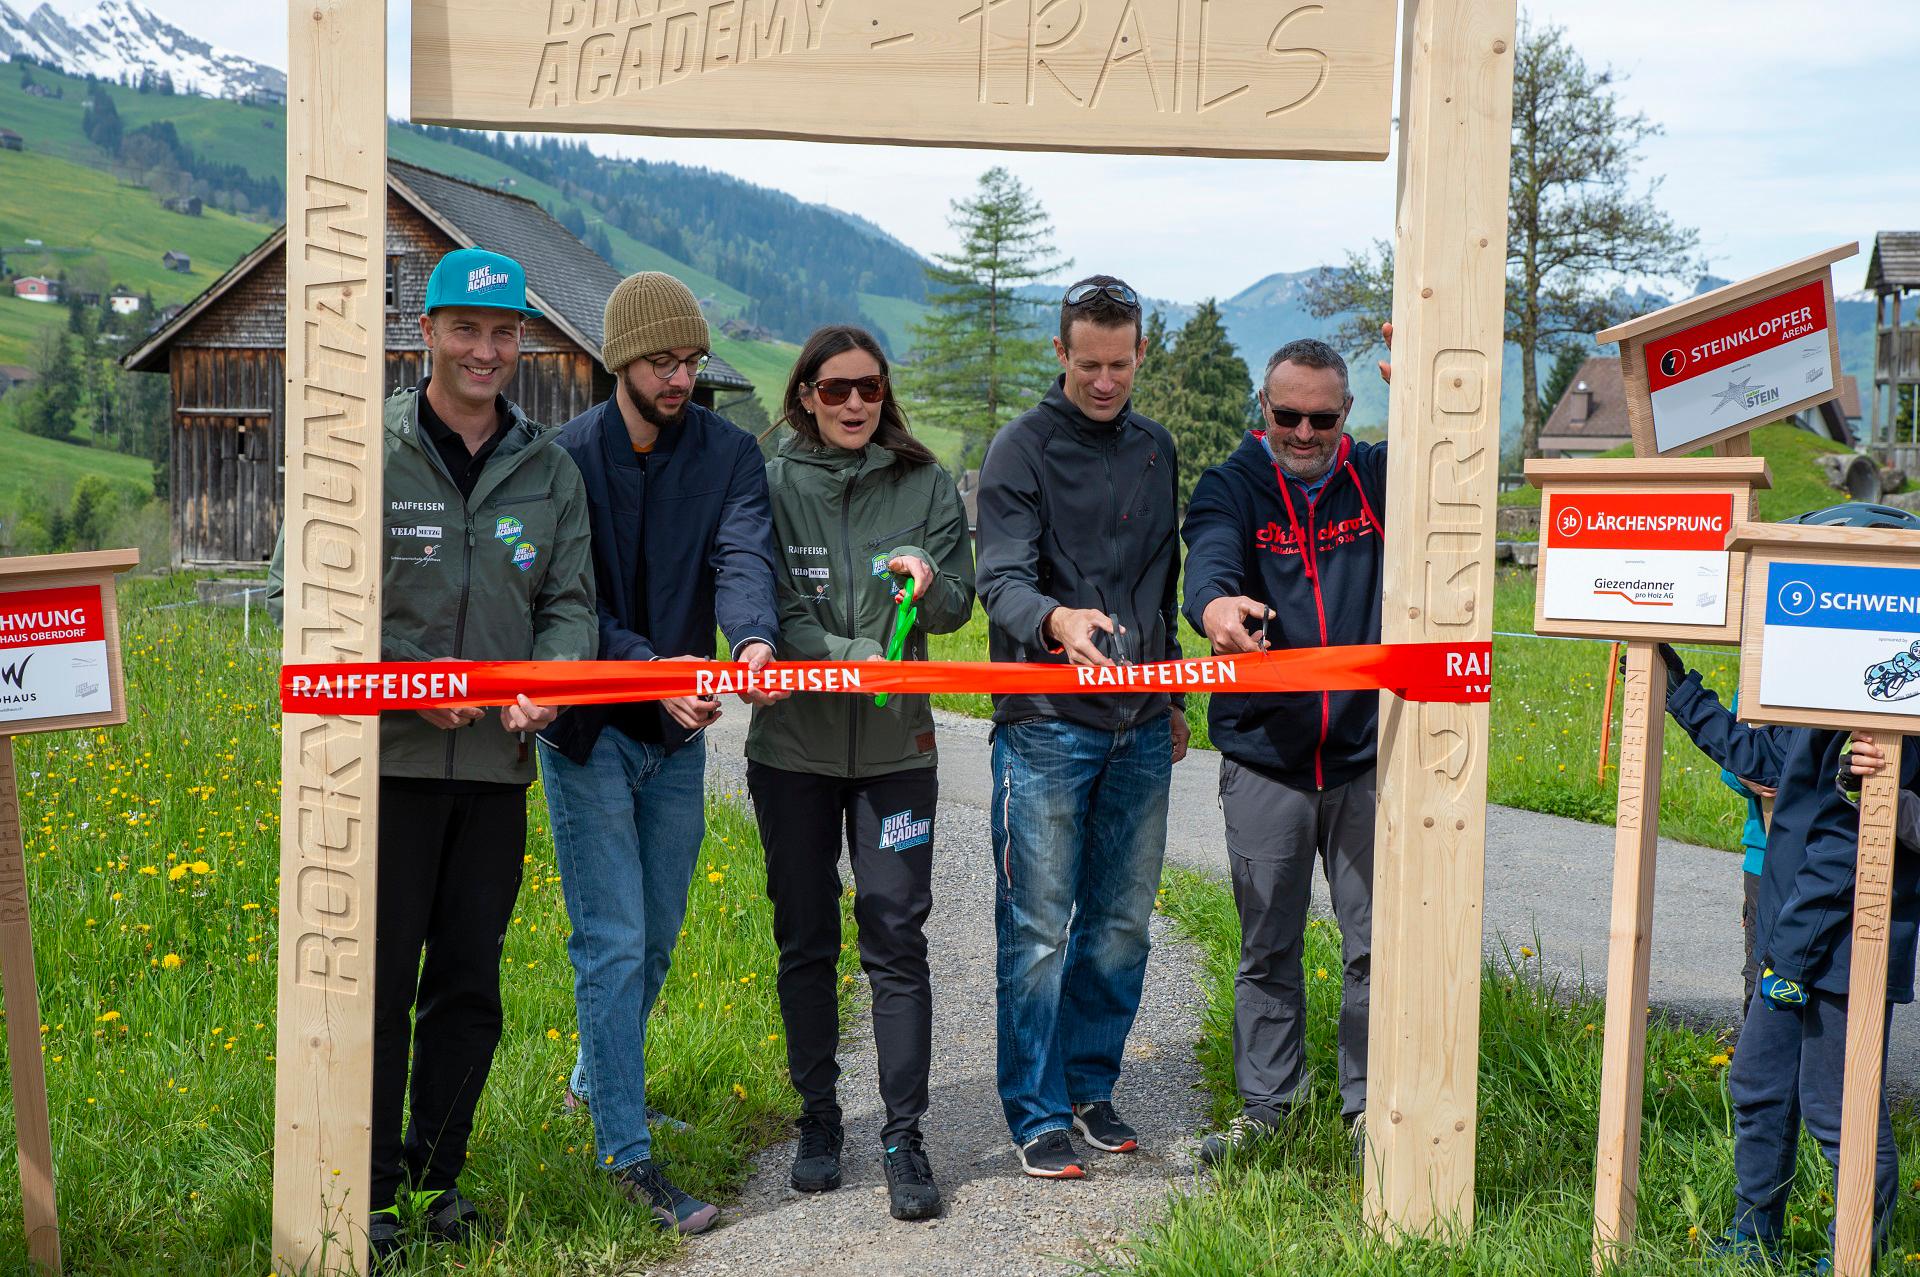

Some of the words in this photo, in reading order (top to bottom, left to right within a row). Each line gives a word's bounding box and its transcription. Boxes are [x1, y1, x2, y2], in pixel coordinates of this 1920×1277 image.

[529, 0, 835, 109] ACADEMY
[958, 0, 1329, 118] TRAILS
[467, 273, 509, 292] ACADEMY
[469, 265, 490, 281] BIKE
[1669, 357, 1677, 369] 7
[1691, 306, 1813, 363] STEINKLOPFER
[1782, 322, 1814, 341] ARENA
[1747, 387, 1779, 408] STEIN
[301, 174, 368, 662] MOUNTAIN
[1423, 347, 1488, 643] GIRO
[391, 501, 445, 511] RAIFFEISEN
[391, 527, 416, 536] VELO
[1562, 515, 1577, 530] 3b
[1587, 512, 1723, 532] LÄRCHENSPRUNG
[788, 545, 828, 555] RAIFFEISEN
[1335, 533, 1355, 548] 1936
[1594, 578, 1675, 591] Giezendanner
[1792, 591, 1803, 606] 9
[1820, 592, 1920, 614] SCHWEN
[30, 628, 87, 641] OBERDORF
[696, 667, 861, 695] RAIFFEISEN
[1077, 660, 1237, 686] RAIFFEISEN
[292, 673, 468, 699] RAIFFEISEN
[0, 693, 37, 704] HAUS
[1618, 669, 1648, 831] RAIFFEISEN
[884, 812, 910, 833] BIKE
[881, 820, 930, 847] ACADEMY
